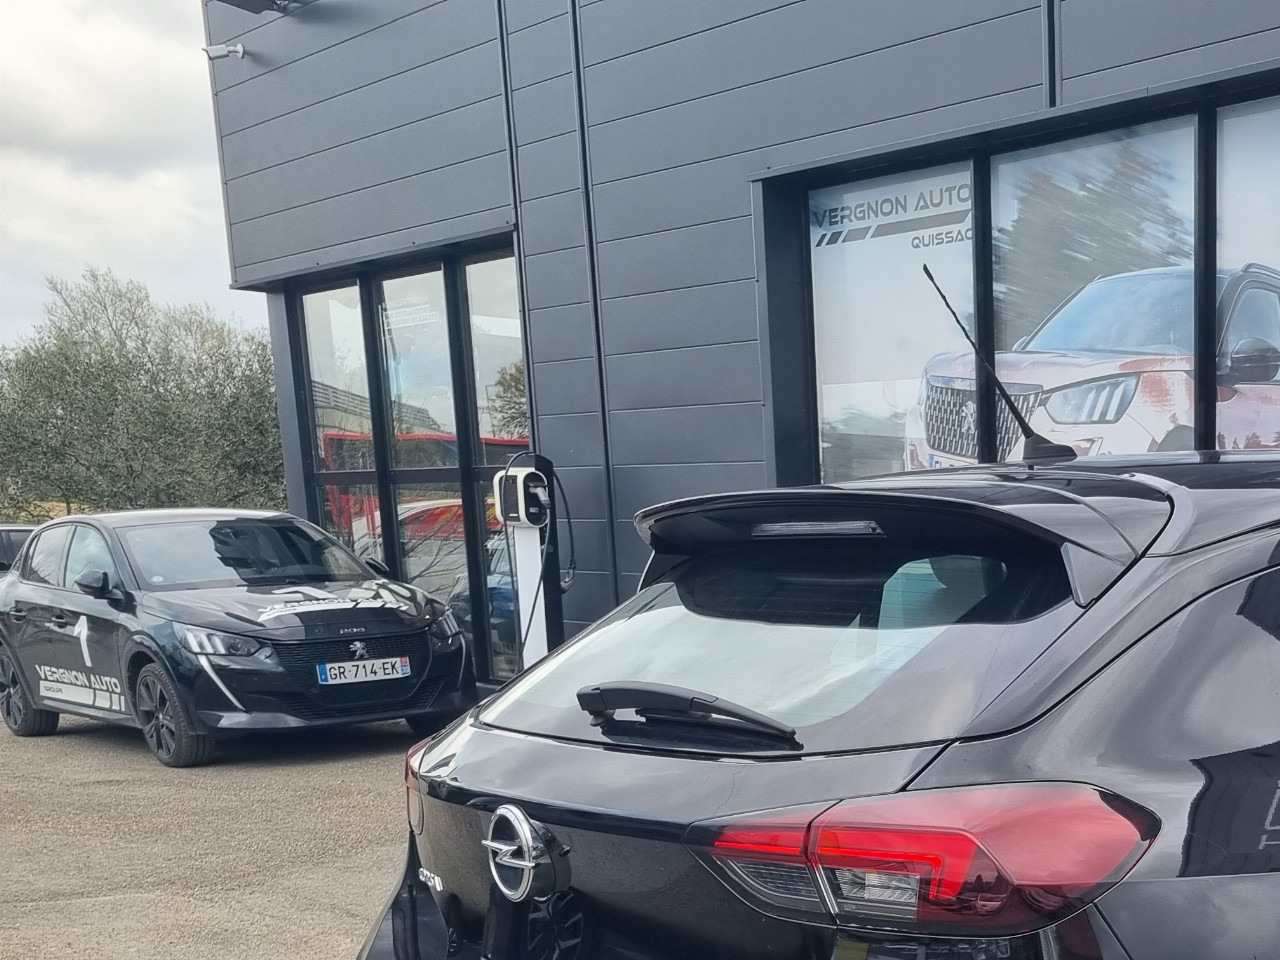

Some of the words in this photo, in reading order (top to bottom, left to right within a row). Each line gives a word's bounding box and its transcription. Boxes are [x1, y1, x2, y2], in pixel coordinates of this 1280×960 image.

[813, 195, 908, 229] VERGNON
[914, 183, 972, 211] AUTO
[911, 227, 974, 249] QUISSAC
[35, 664, 89, 687] VERGNON
[90, 674, 121, 693] AUTO
[329, 661, 399, 680] GR-714-EK
